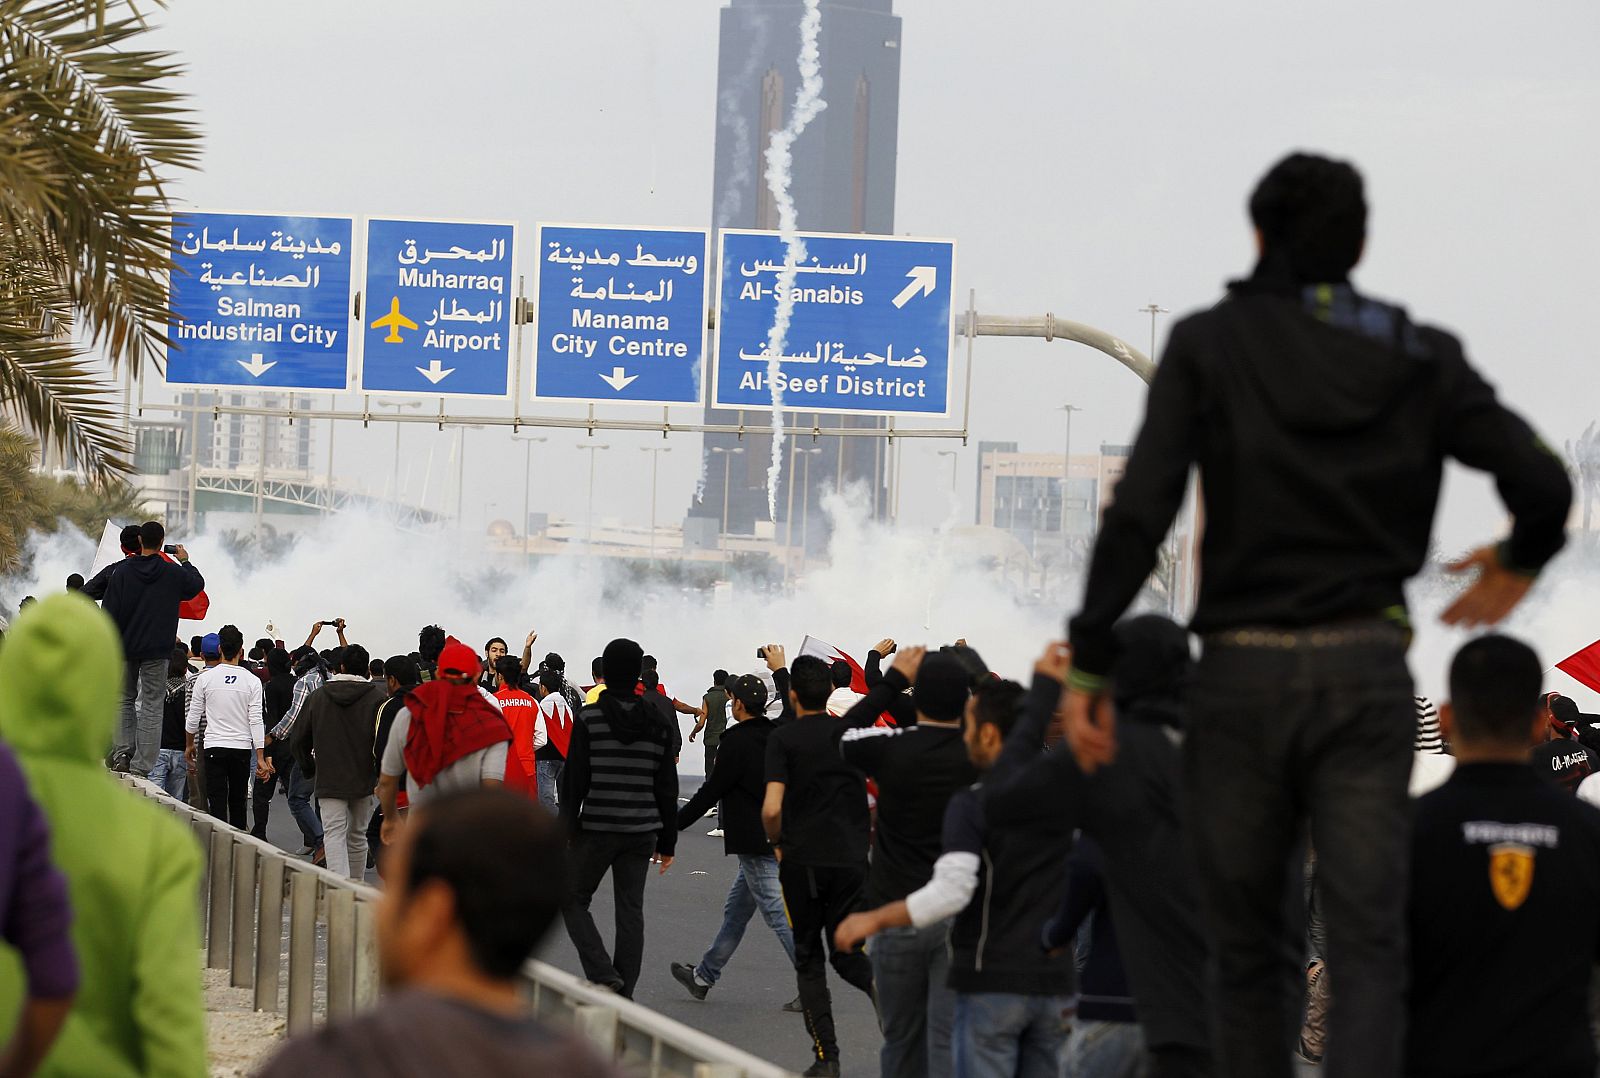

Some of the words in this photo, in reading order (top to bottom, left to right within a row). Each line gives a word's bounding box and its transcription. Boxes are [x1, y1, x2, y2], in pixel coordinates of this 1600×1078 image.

[181, 226, 267, 255] سلمان
[270, 230, 341, 259] مدينة
[398, 238, 505, 265] المحرق
[547, 241, 620, 271] مدينة
[625, 243, 698, 275] وسط
[199, 263, 320, 291] الصناعية
[398, 267, 504, 295] Muharraq
[570, 276, 673, 304] المنامة
[217, 296, 301, 319] Salman
[424, 297, 502, 326] المطار
[572, 308, 669, 331] Manama
[177, 320, 282, 342] Industrial
[290, 323, 338, 348] City
[422, 329, 501, 353] Airport
[551, 333, 598, 358] City
[608, 335, 688, 358] Centre
[830, 342, 928, 372] ضاحية
[739, 371, 829, 395] Al-Seef
[836, 374, 926, 398] District
[224, 675, 237, 684] 27
[500, 698, 532, 708] BAHRAIN
